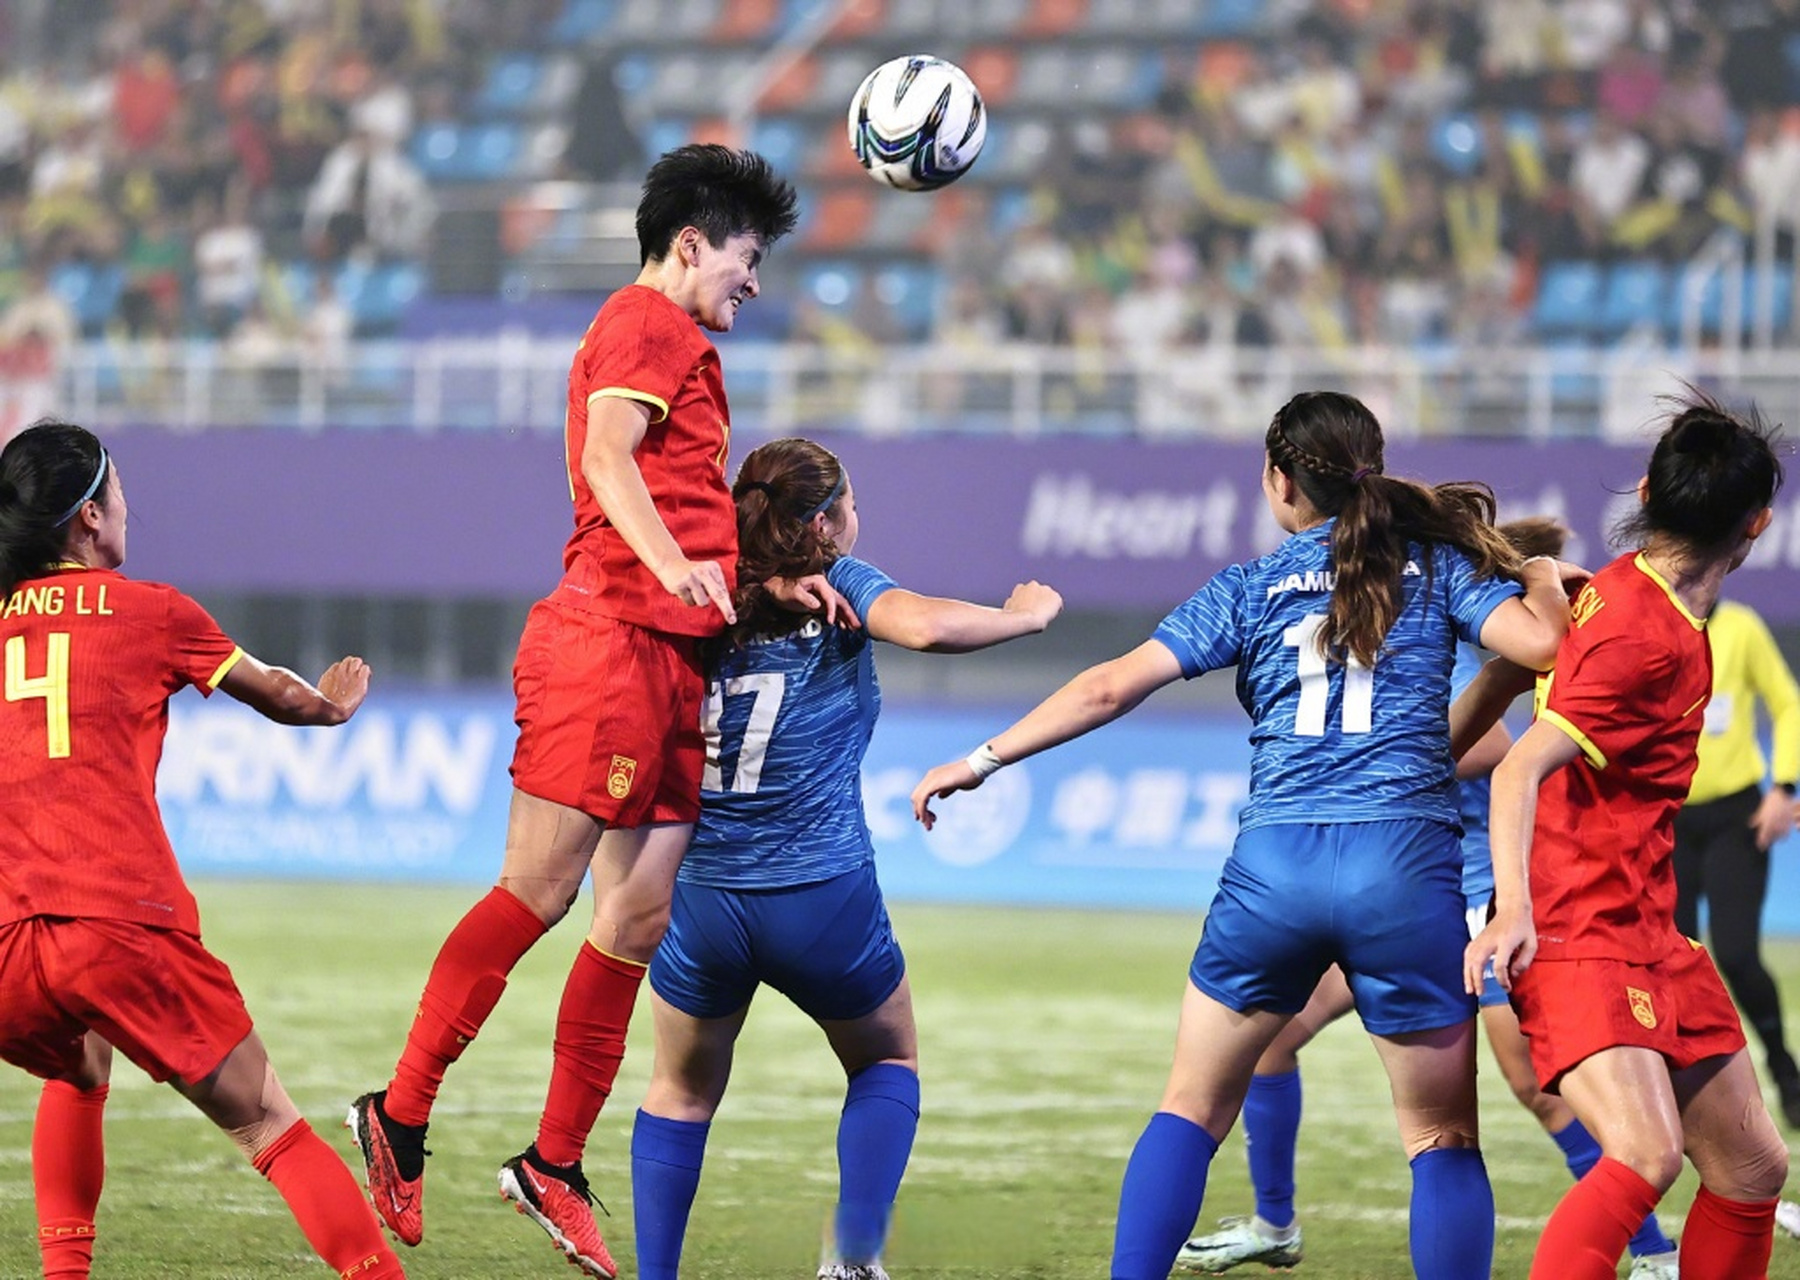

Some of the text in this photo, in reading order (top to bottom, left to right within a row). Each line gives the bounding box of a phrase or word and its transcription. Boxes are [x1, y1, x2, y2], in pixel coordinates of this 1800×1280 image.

[1023, 474, 1238, 558] Heart
[0, 586, 65, 619] ANG
[5, 632, 71, 759] 4
[701, 672, 785, 794] 17
[1283, 614, 1379, 737] 11
